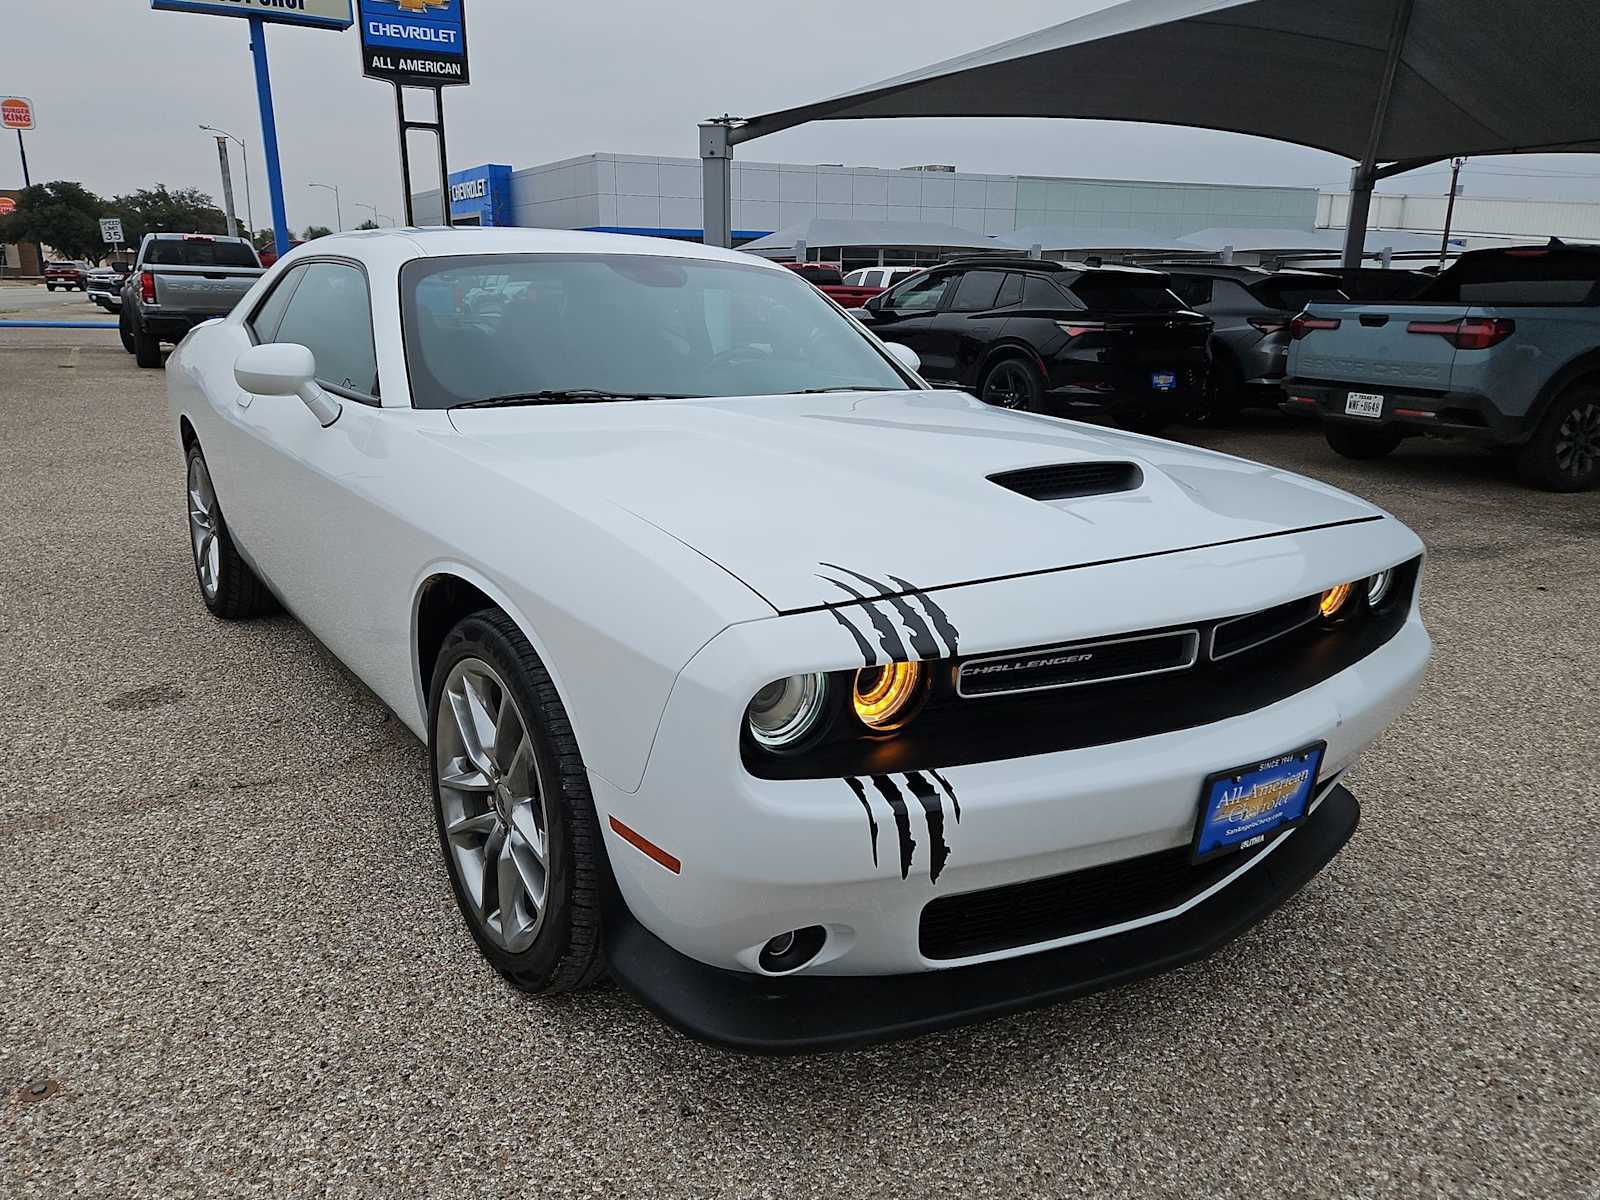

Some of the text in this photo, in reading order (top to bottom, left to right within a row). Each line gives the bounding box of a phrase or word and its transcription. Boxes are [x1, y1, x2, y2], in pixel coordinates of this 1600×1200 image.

[369, 22, 456, 43] CHEVROLET
[372, 56, 461, 75] ALL AMERICAN
[3, 113, 31, 122] KING
[452, 179, 485, 202] CHEVROLET
[105, 231, 121, 241] 35
[961, 653, 1093, 677] CHALLENGER
[1259, 759, 1281, 771] SINCE
[1216, 769, 1309, 809] All American
[1228, 791, 1289, 823] Chevrolet
